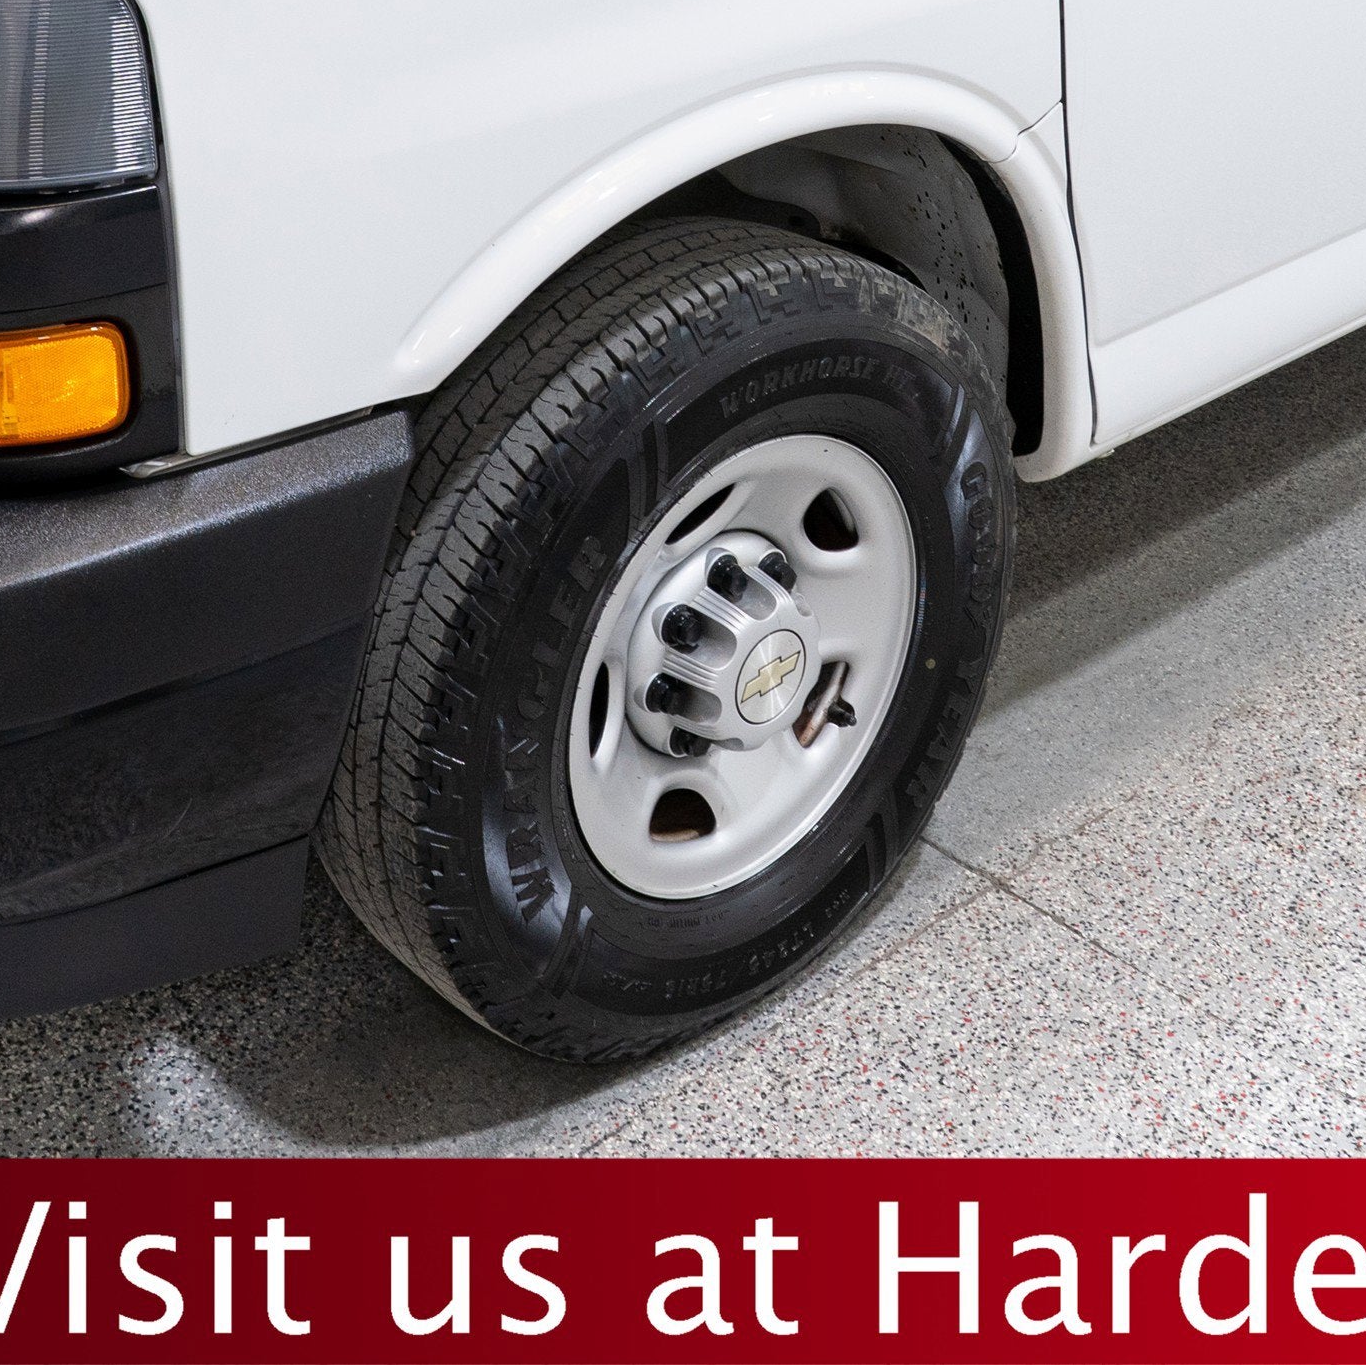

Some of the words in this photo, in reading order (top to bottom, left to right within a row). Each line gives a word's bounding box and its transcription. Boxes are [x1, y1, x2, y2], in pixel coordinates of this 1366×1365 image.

[719, 355, 880, 419] WORKHORSE
[503, 535, 607, 926] WRANGLER
[905, 461, 996, 808] GOODYEAR
